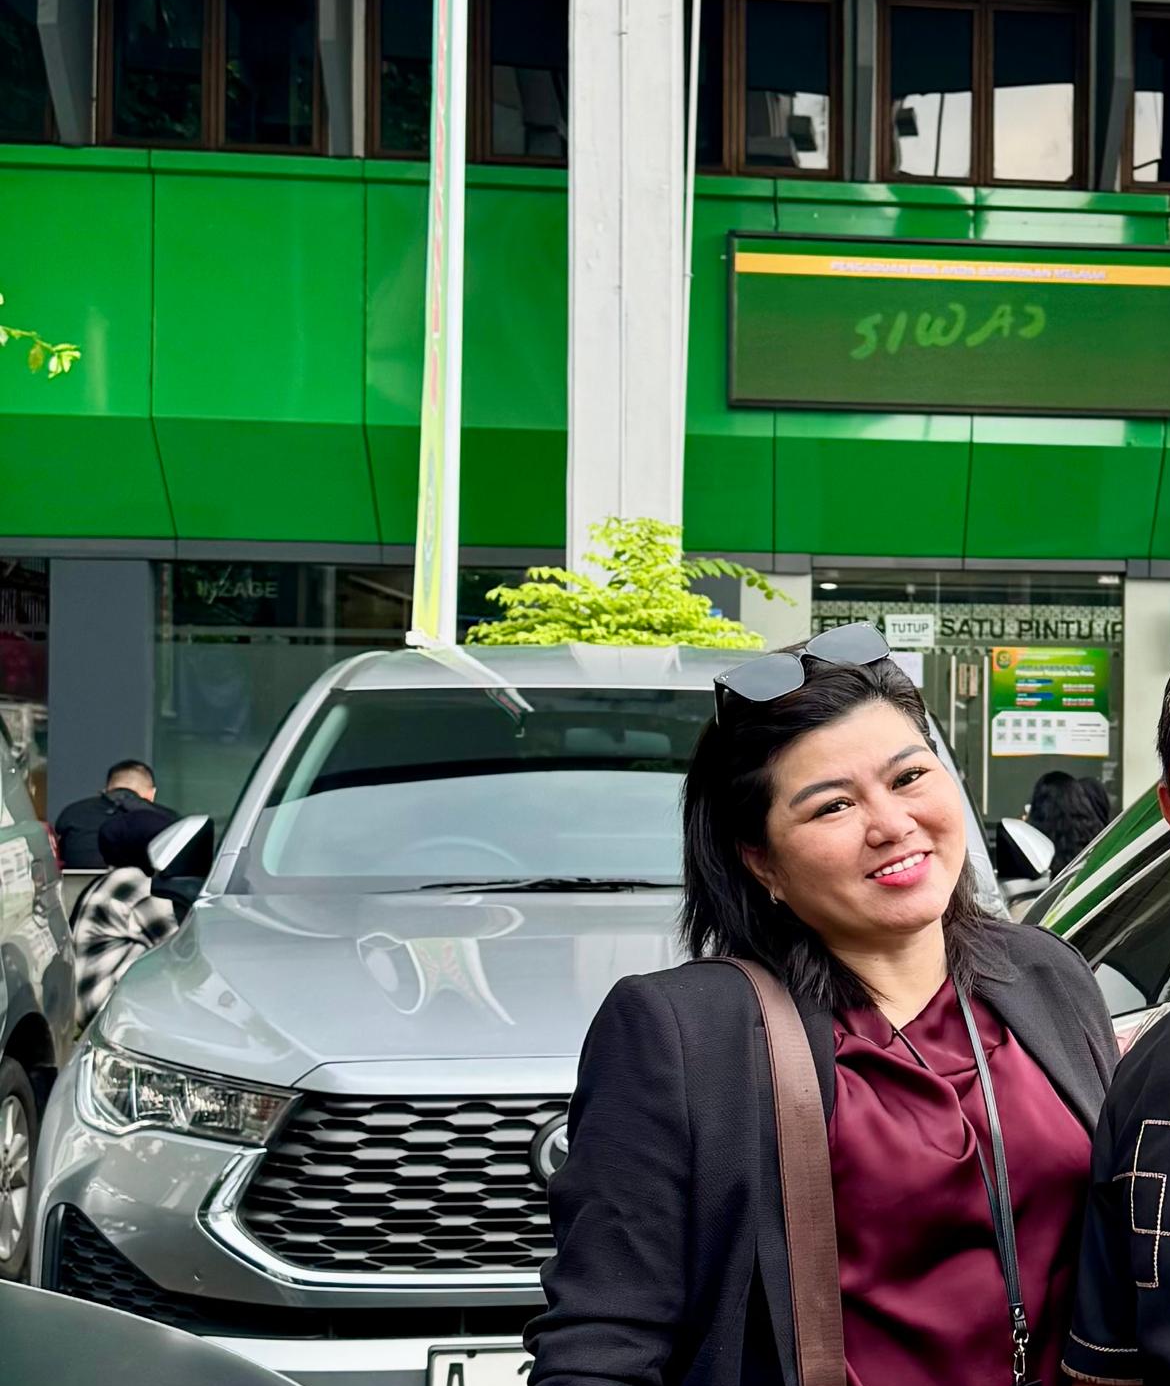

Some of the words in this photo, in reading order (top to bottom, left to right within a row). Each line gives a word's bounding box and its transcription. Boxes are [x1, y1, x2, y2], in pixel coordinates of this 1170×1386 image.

[891, 622, 930, 634] TUTUP
[940, 617, 1006, 639] SATU
[1016, 619, 1094, 640] PINTU
